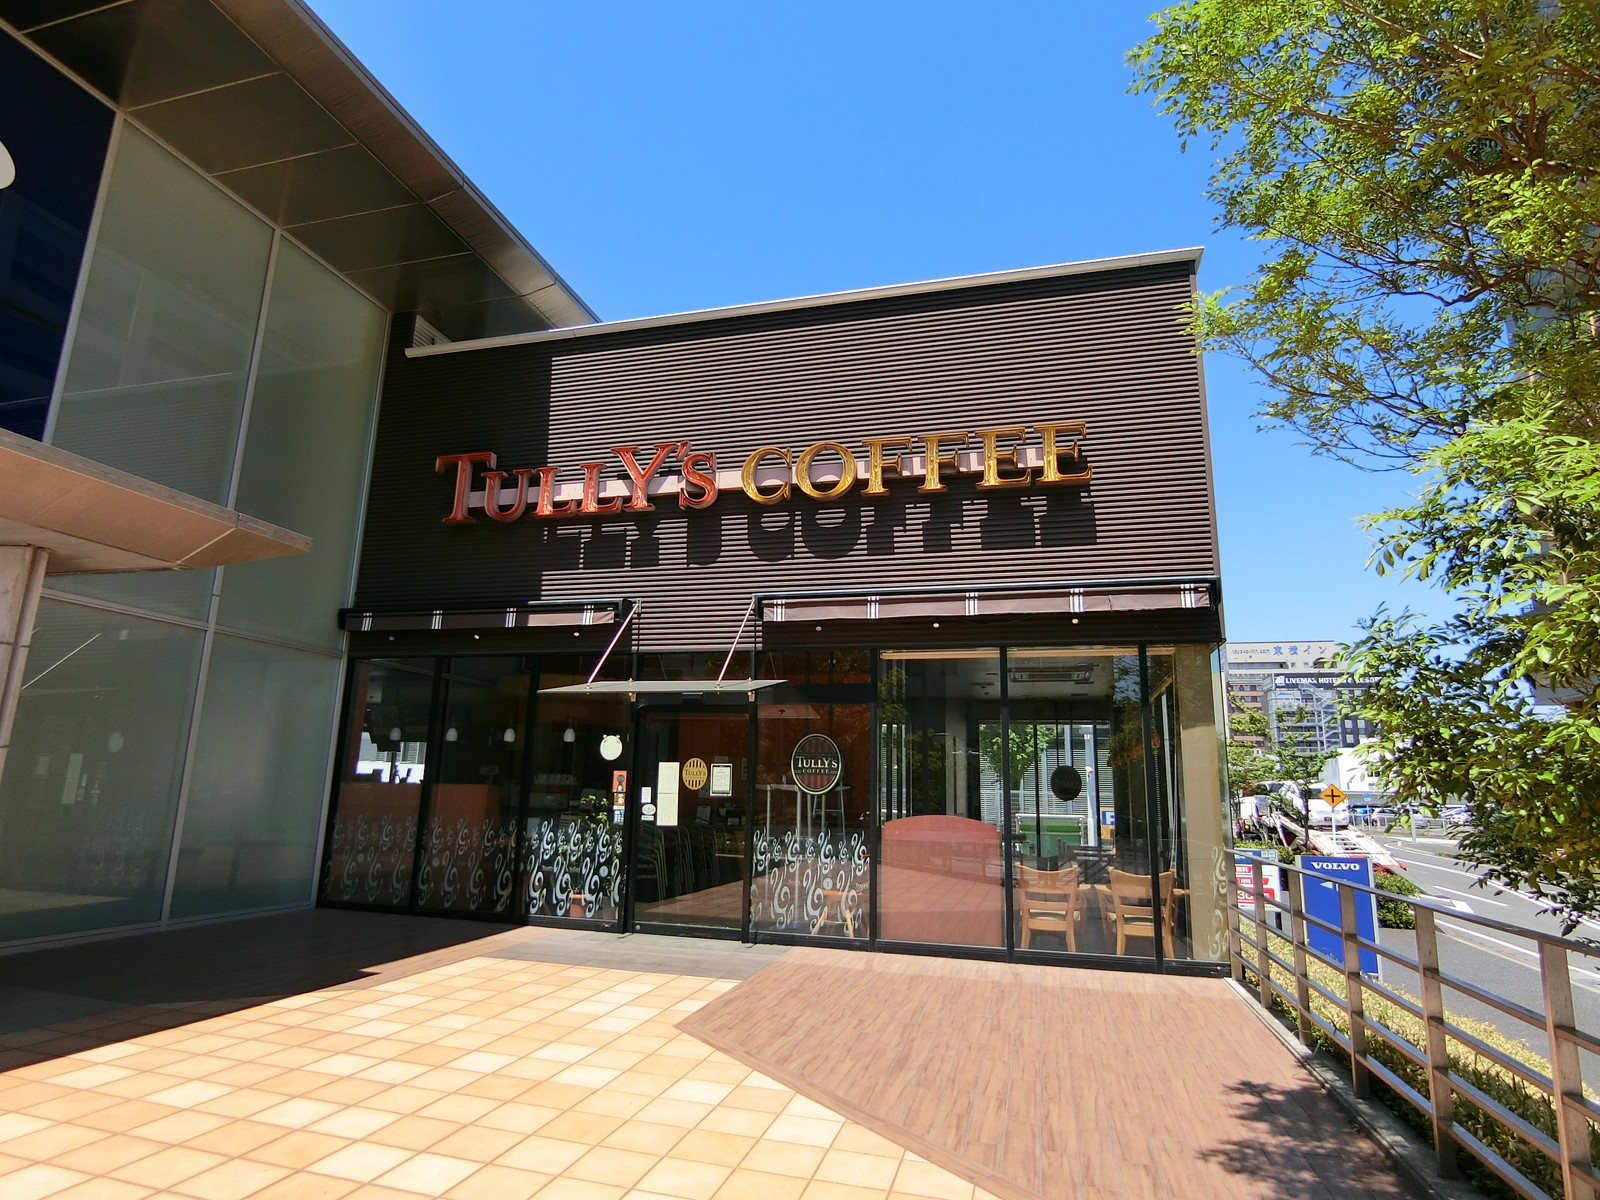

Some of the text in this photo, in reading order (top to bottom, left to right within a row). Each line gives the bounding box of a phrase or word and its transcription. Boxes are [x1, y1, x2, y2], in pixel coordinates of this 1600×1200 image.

[435, 421, 1093, 524] TULLY'S COFFEE
[795, 755, 838, 769] TULLY'S
[1310, 861, 1360, 871] VOLVO
